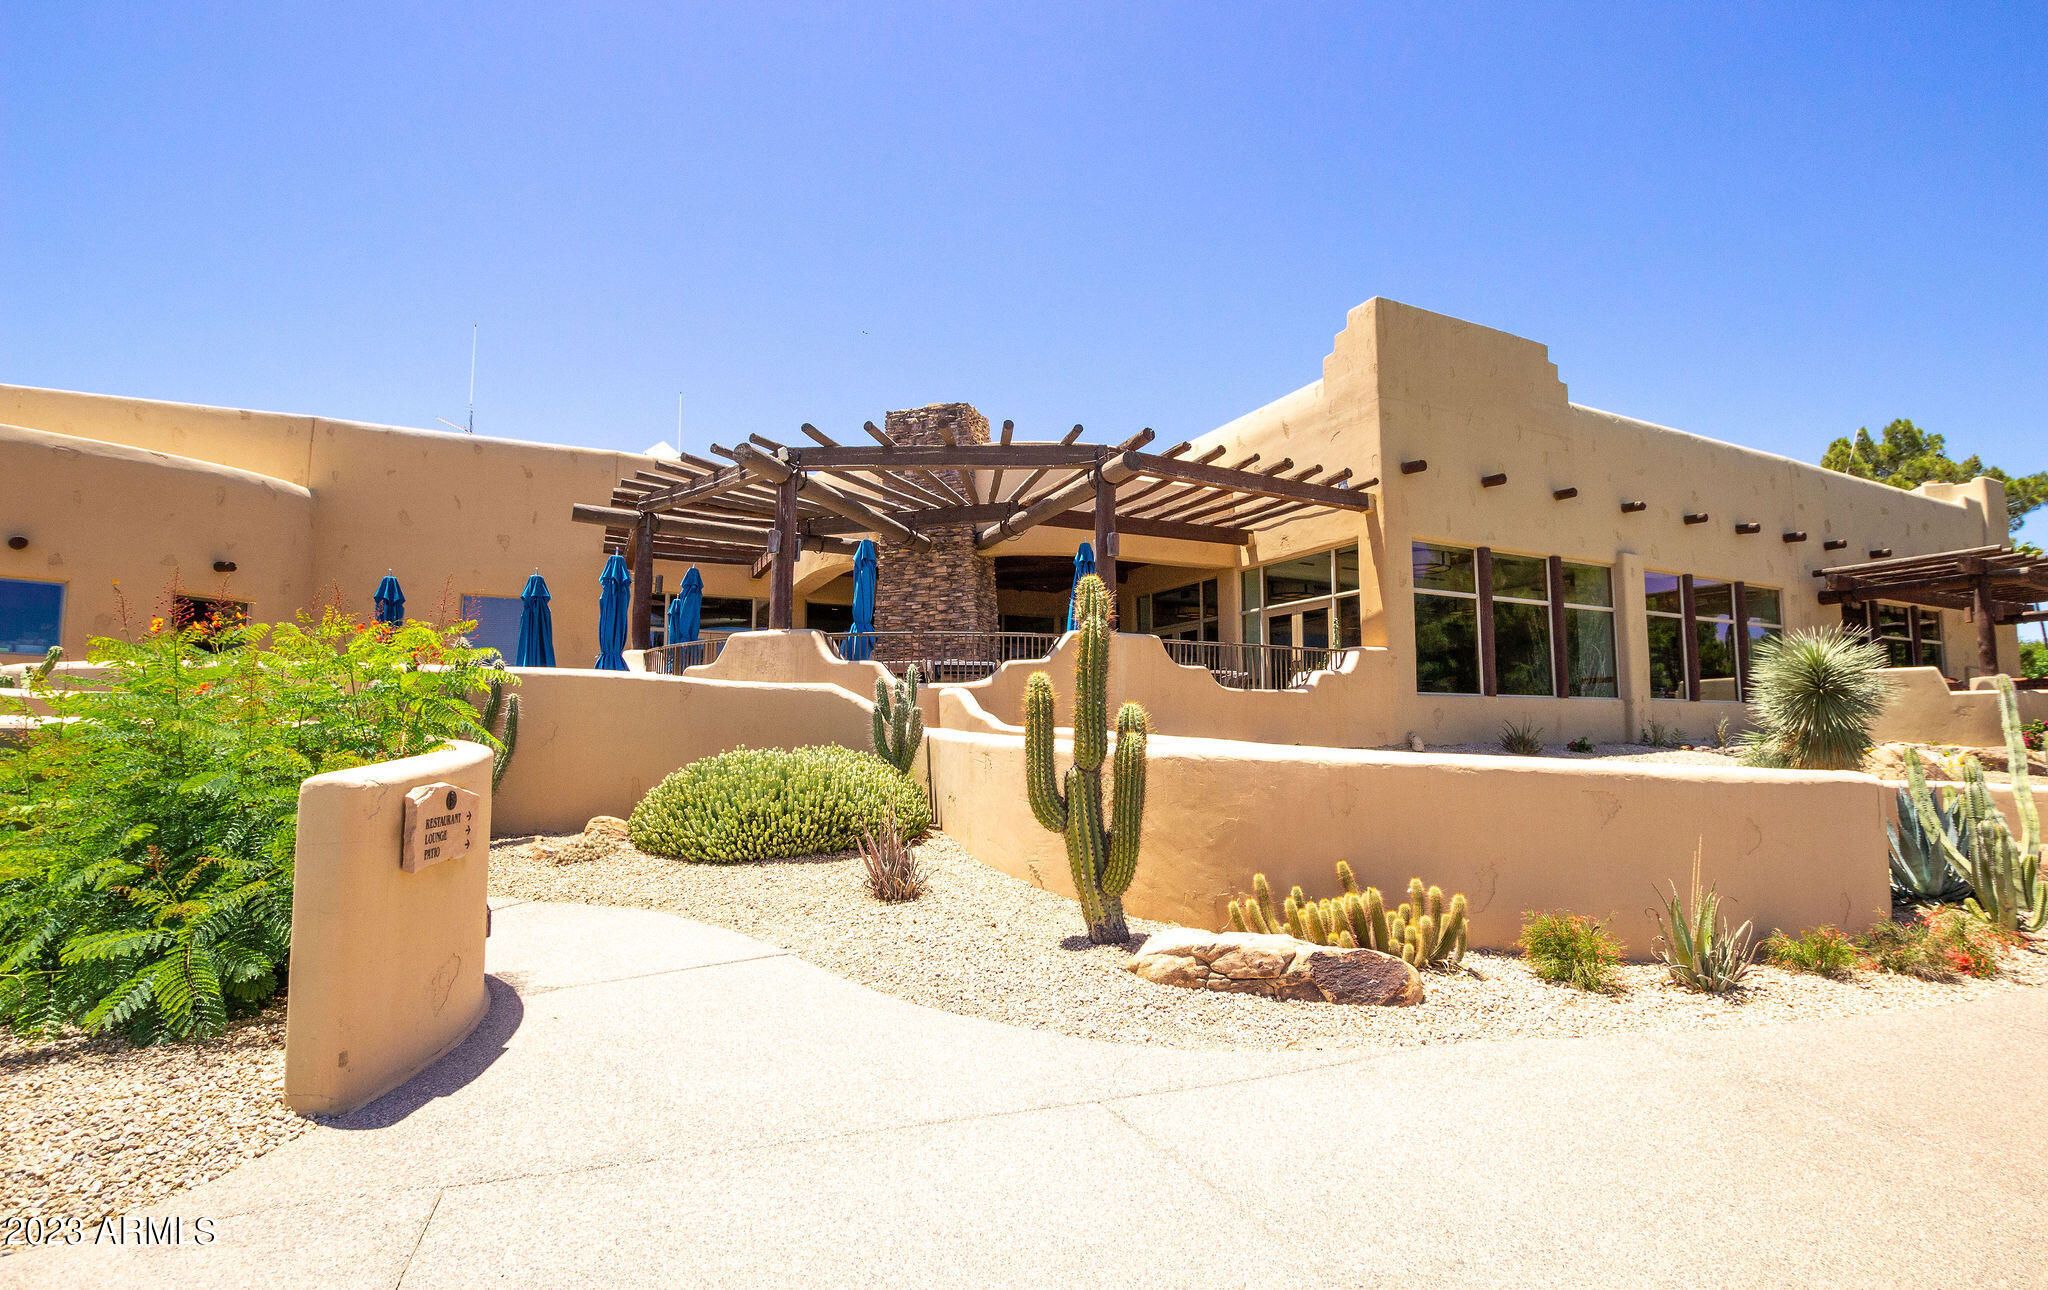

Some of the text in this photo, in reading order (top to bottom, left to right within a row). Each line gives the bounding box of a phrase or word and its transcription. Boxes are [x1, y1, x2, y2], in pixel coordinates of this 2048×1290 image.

[425, 813, 461, 829] RESTAURANT
[425, 830, 447, 845] LOUNGE
[424, 847, 440, 860] PATIO
